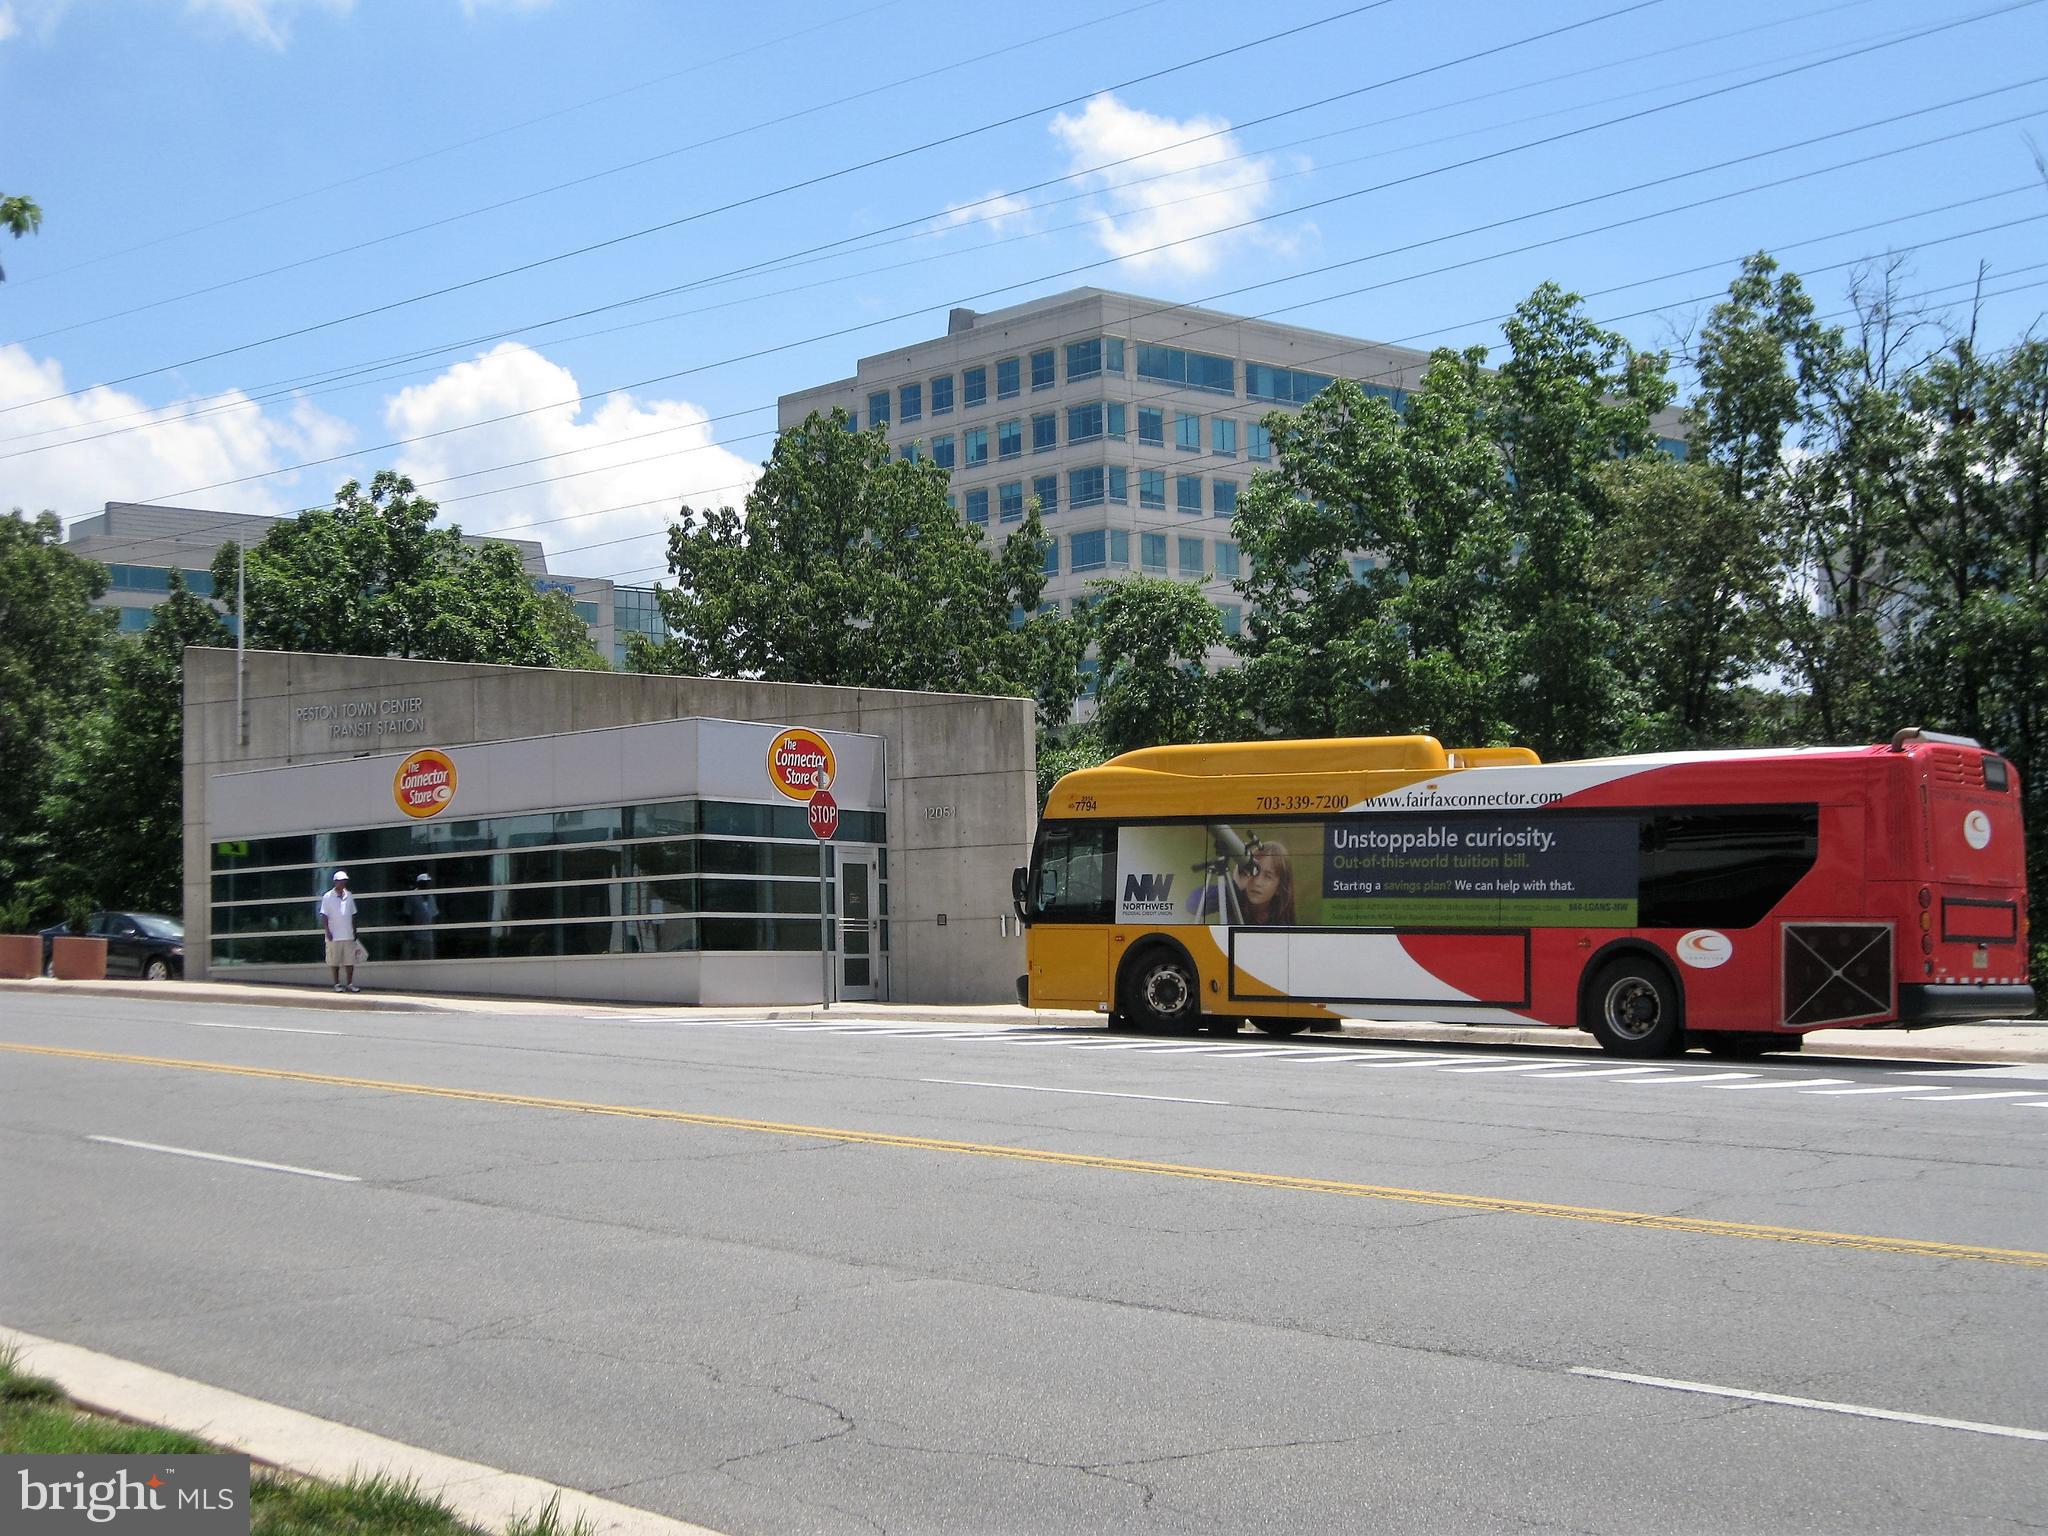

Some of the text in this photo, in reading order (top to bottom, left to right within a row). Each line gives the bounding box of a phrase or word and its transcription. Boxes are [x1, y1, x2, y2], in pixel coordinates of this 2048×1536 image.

[296, 697, 423, 721] RESTON TOWN CENTER
[329, 716, 425, 738] TRANSIT STATION
[784, 737, 797, 750] The
[775, 749, 827, 768] Connector
[407, 762, 420, 773] The
[400, 769, 449, 790] Connector
[785, 768, 810, 785] Store
[409, 789, 432, 805] Store
[1256, 795, 1349, 810] 703-339-7200
[1365, 791, 1563, 808] www.fairfaxconnector.com
[811, 805, 836, 824] STOP
[1075, 801, 1097, 812] 7794
[1333, 826, 1556, 853] Unstoppable curiosity.
[1333, 853, 1530, 869] Out-of-this-world tuition bill.
[1124, 874, 1175, 901] NW
[1333, 879, 1575, 893] Startng a savings plan? We can help with that.
[1123, 902, 1174, 911] NORTHWEST
